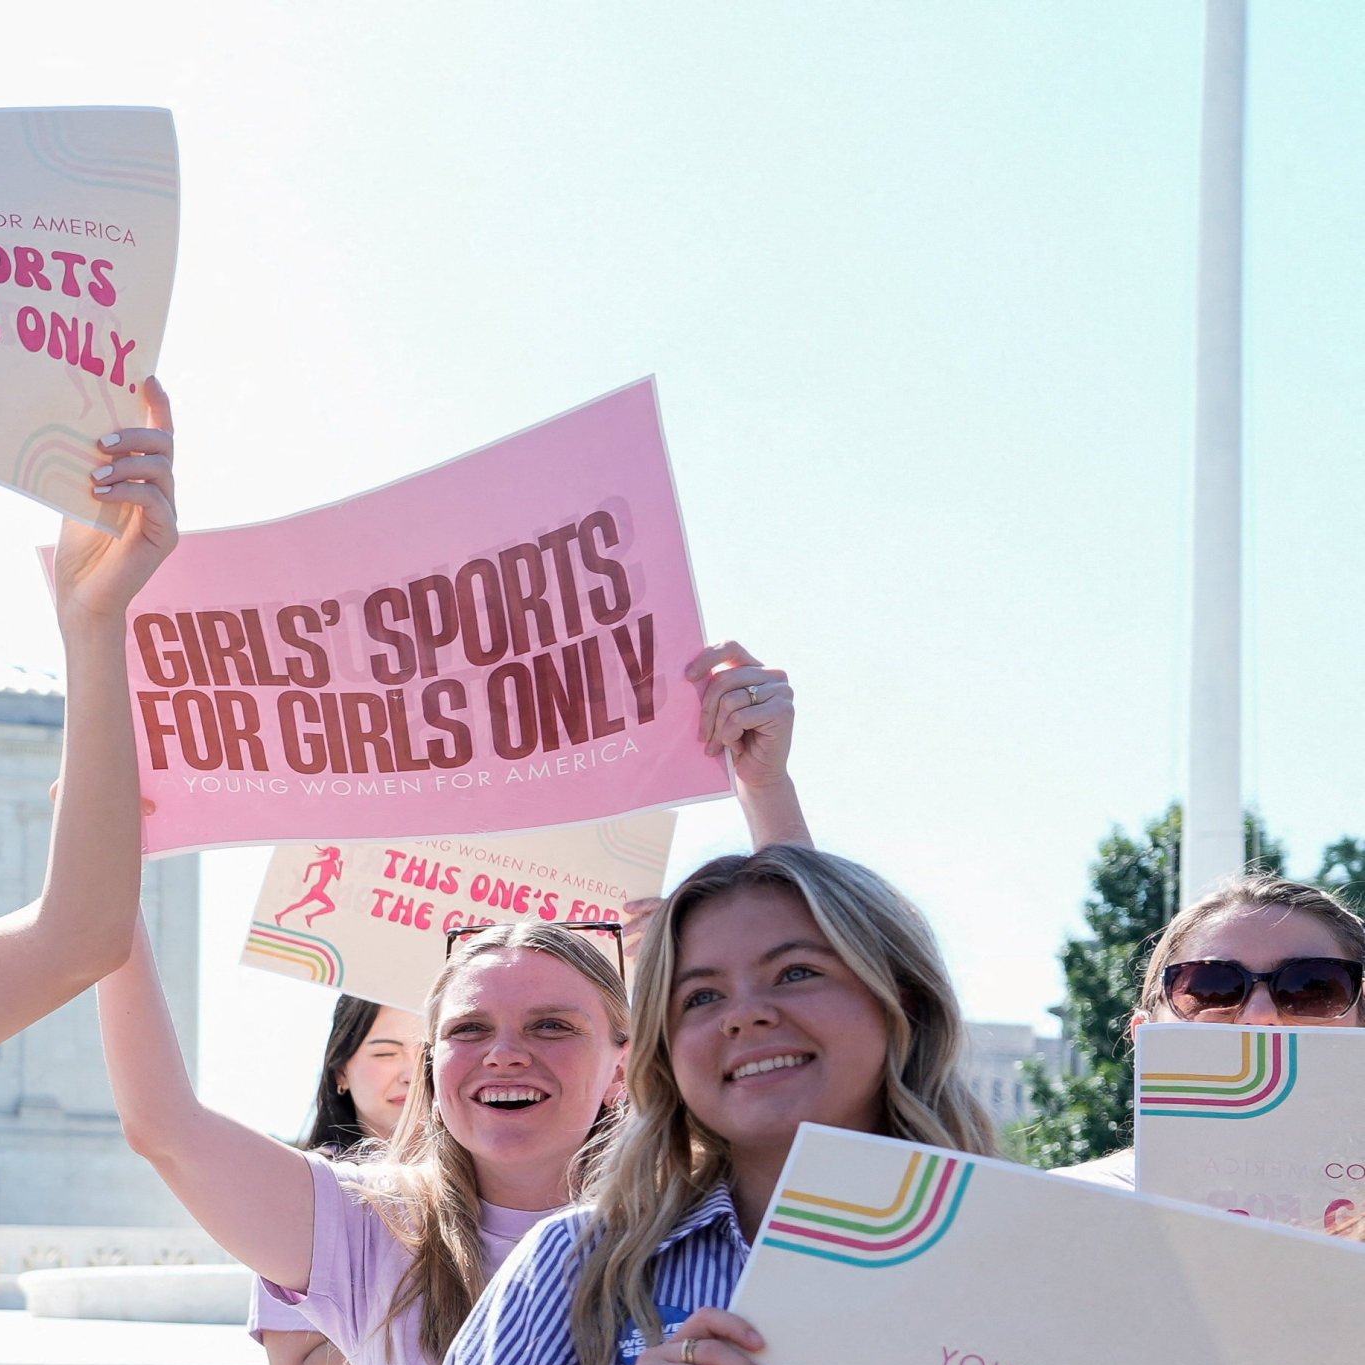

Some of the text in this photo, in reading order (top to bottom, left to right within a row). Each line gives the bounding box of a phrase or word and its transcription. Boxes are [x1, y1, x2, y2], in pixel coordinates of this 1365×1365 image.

[33, 216, 137, 247] AMERICA
[16, 305, 136, 394] ONLY.
[365, 510, 632, 686] SPORTS
[137, 613, 656, 774] FOR GIRLS ONLY
[182, 737, 640, 796] YOUNG WOMEN FOR AMERICA
[383, 849, 462, 895] THIS
[470, 873, 559, 921] ONE'S
[458, 843, 523, 872] WOMEN
[528, 863, 558, 882] FOR
[562, 872, 629, 902] AMERICA
[370, 888, 435, 931] THE
